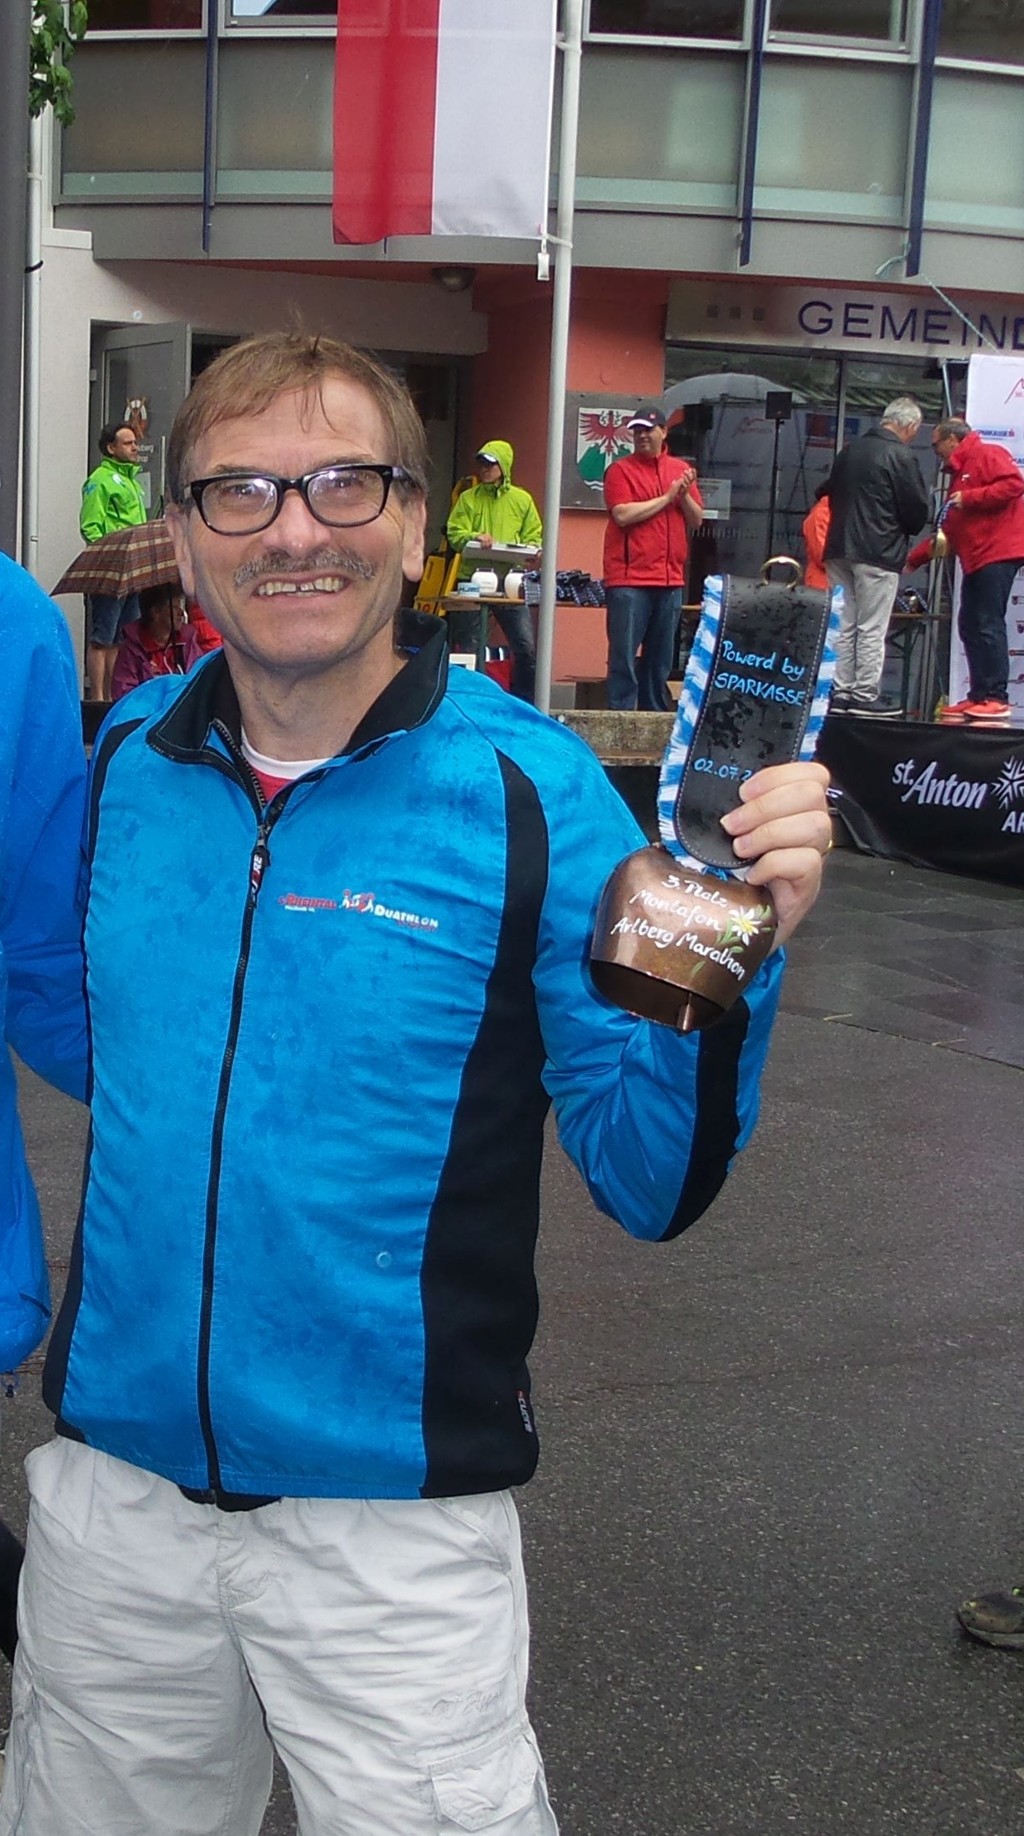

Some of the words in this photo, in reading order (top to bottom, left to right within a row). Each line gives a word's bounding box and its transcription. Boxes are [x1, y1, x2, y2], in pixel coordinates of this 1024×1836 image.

[722, 640, 774, 670] Powerd
[781, 658, 805, 682] by
[714, 672, 806, 706] SPARKASSE
[694, 758, 752, 781] 02.07.2
[901, 761, 987, 809] Anton
[629, 889, 723, 931] Montafon
[684, 880, 729, 908] Platz
[374, 904, 439, 928] DUATHLON
[610, 917, 674, 948] Arlberg
[676, 932, 746, 981] Marathon
